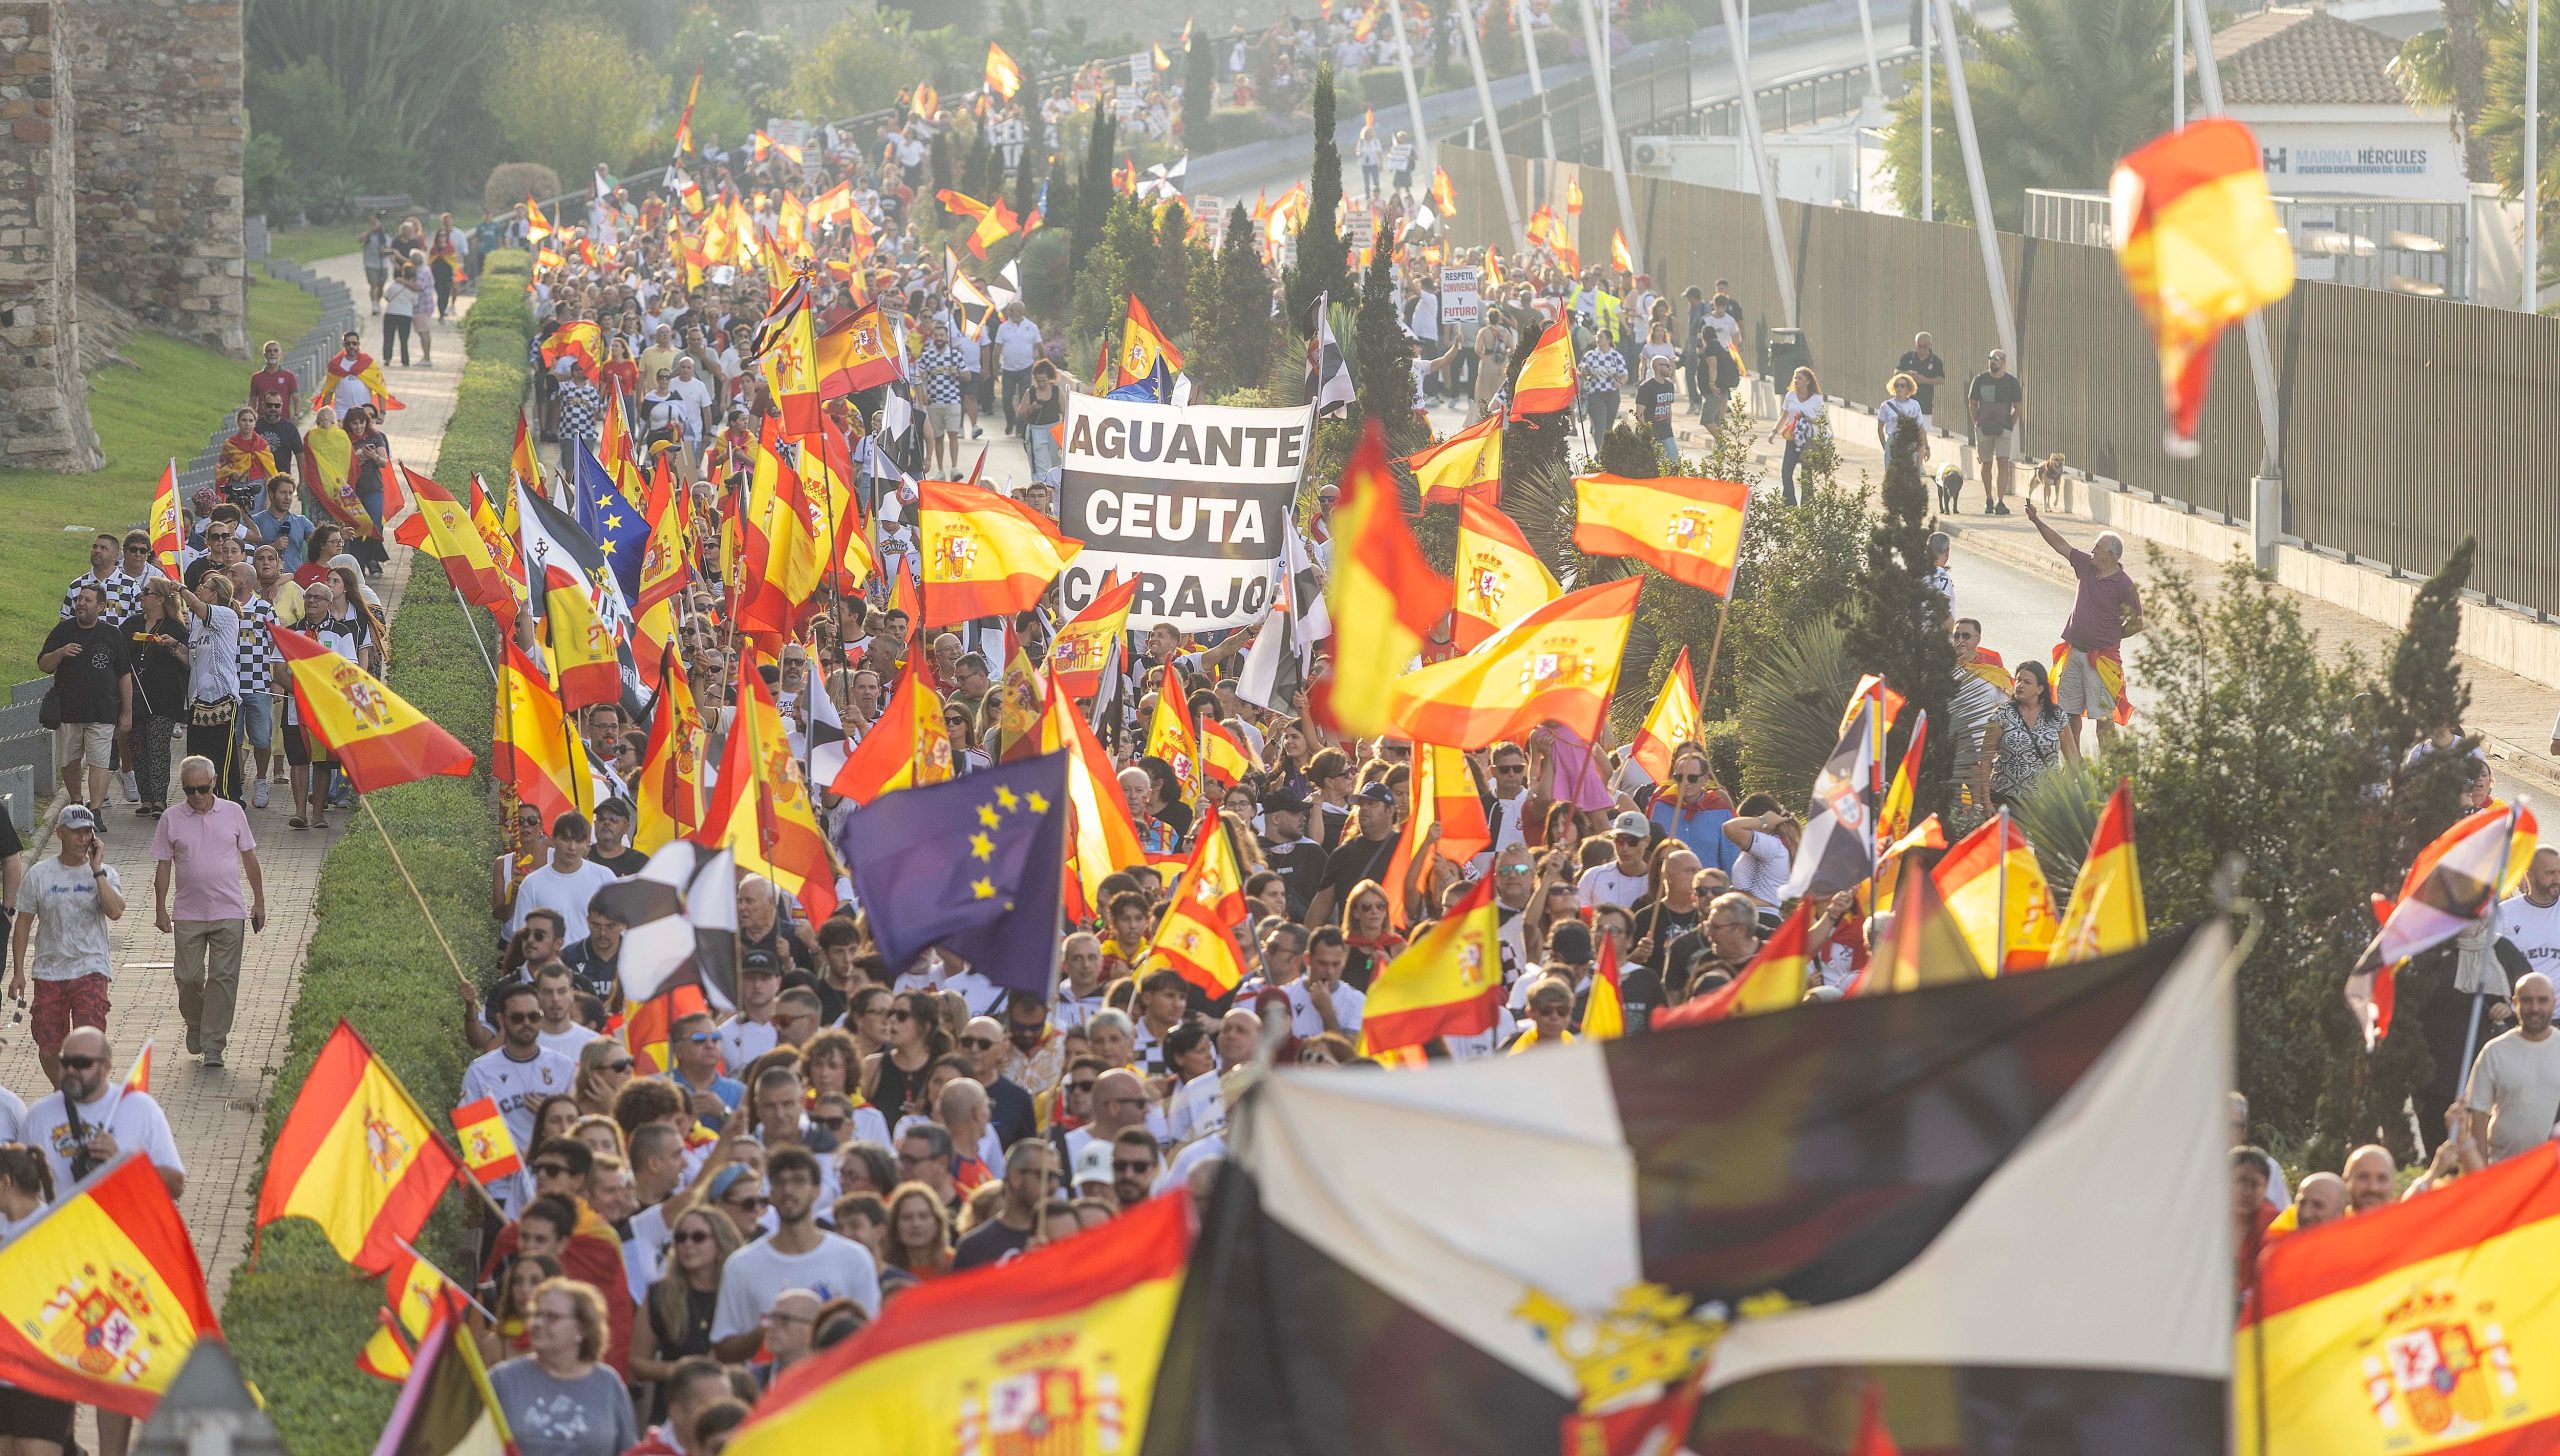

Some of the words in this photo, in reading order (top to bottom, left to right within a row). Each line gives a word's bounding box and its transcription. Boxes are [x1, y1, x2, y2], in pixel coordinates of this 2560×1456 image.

[2296, 150, 2351, 164] MARINA
[2358, 147, 2426, 164] HÉRCULES
[2298, 165, 2332, 174] PUERTO
[2334, 165, 2380, 174] DEPORTIVO
[2396, 165, 2422, 174] CEUTA
[1445, 272, 1475, 281] RESPETO,
[1443, 282, 1477, 292] CONVIVENCIA
[1458, 297, 1463, 305] Y
[1444, 306, 1477, 317] FUTURO
[1069, 414, 1304, 467] AGUANTE
[1085, 488, 1266, 544] CEUTA
[1064, 566, 1268, 618] CRAJO
[2521, 947, 2560, 960] EUT
